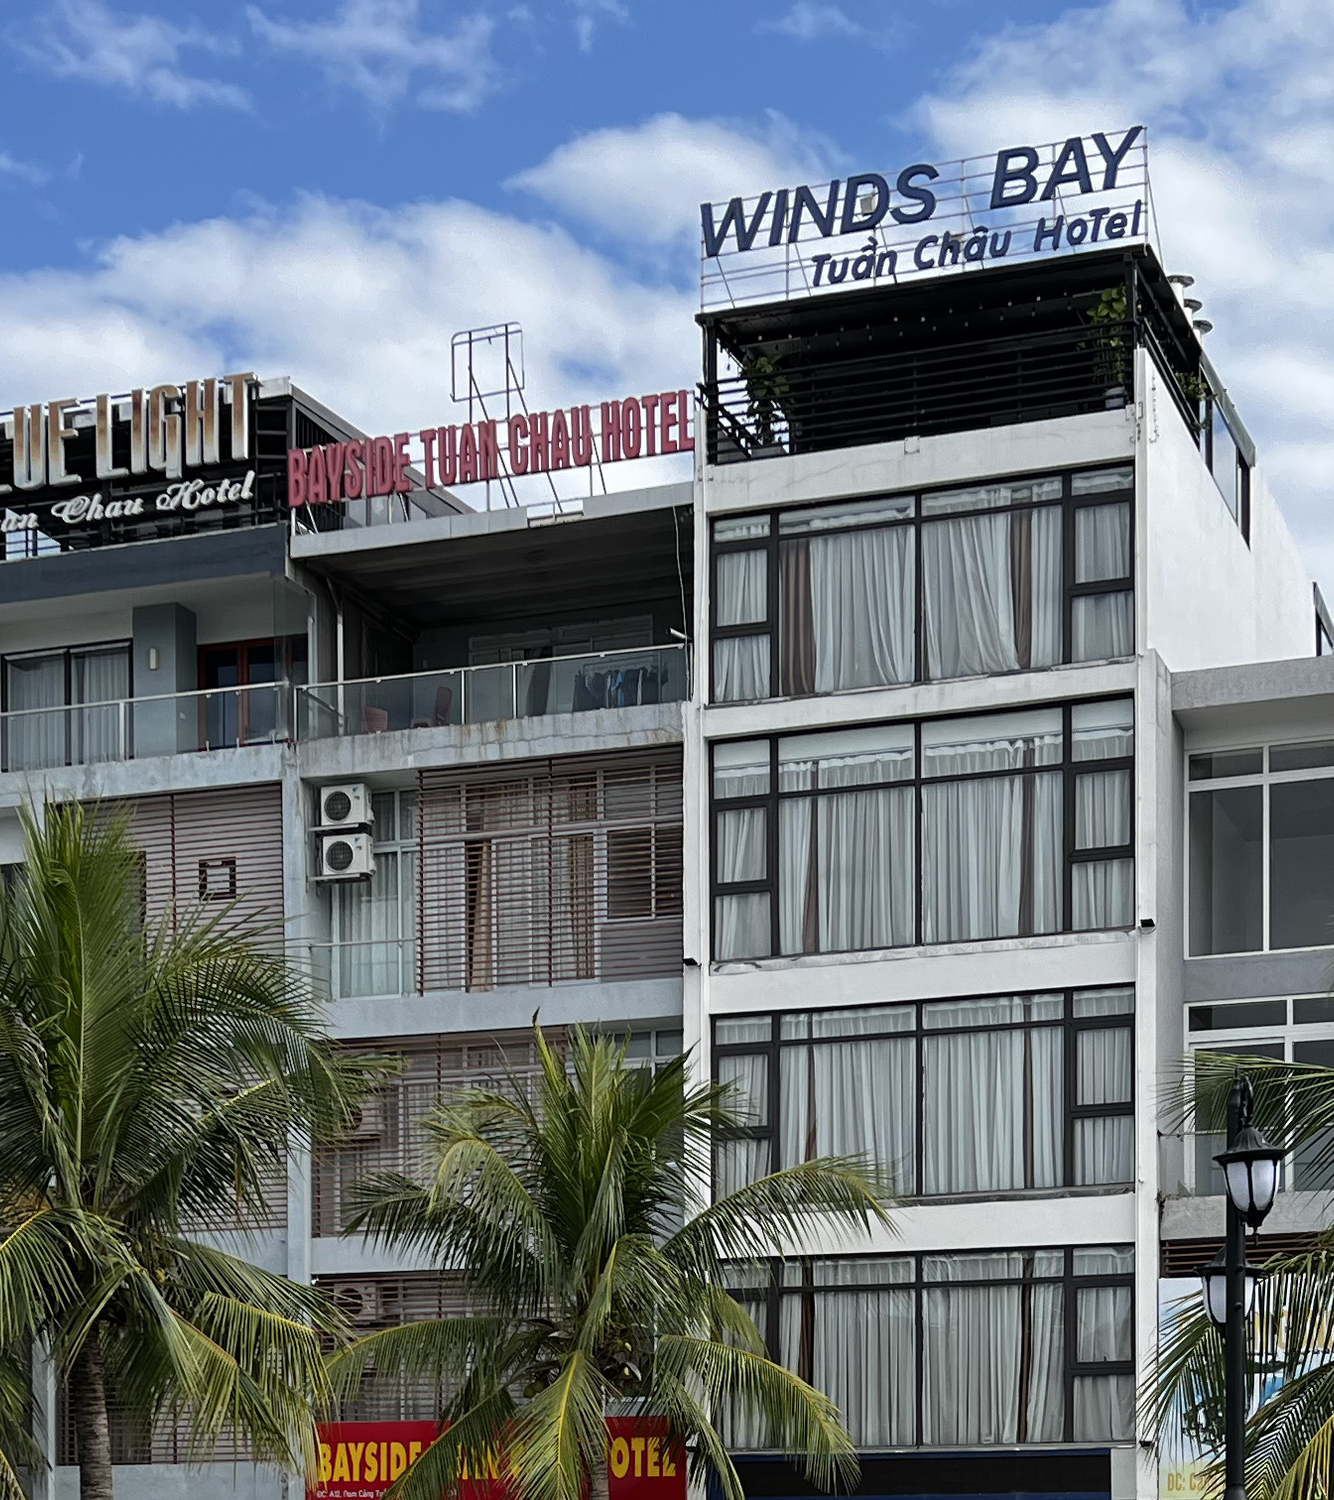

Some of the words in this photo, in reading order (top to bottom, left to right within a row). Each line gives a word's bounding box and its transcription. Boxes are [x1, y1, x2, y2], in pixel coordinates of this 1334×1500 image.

[700, 163, 939, 257] WINDS
[990, 125, 1144, 209] BAY
[811, 235, 898, 287] Tuần
[913, 226, 1011, 272] Châu
[95, 372, 259, 480] LIGHT
[288, 431, 413, 509] BAYSIDE
[420, 418, 499, 490] TUAN
[508, 405, 592, 475] CHAU
[601, 389, 695, 464] HOTEL
[51, 493, 144, 524] Chau
[156, 470, 256, 511] Hotel
[318, 1441, 422, 1483] BAYSIDE
[610, 1436, 676, 1479] OTEL
